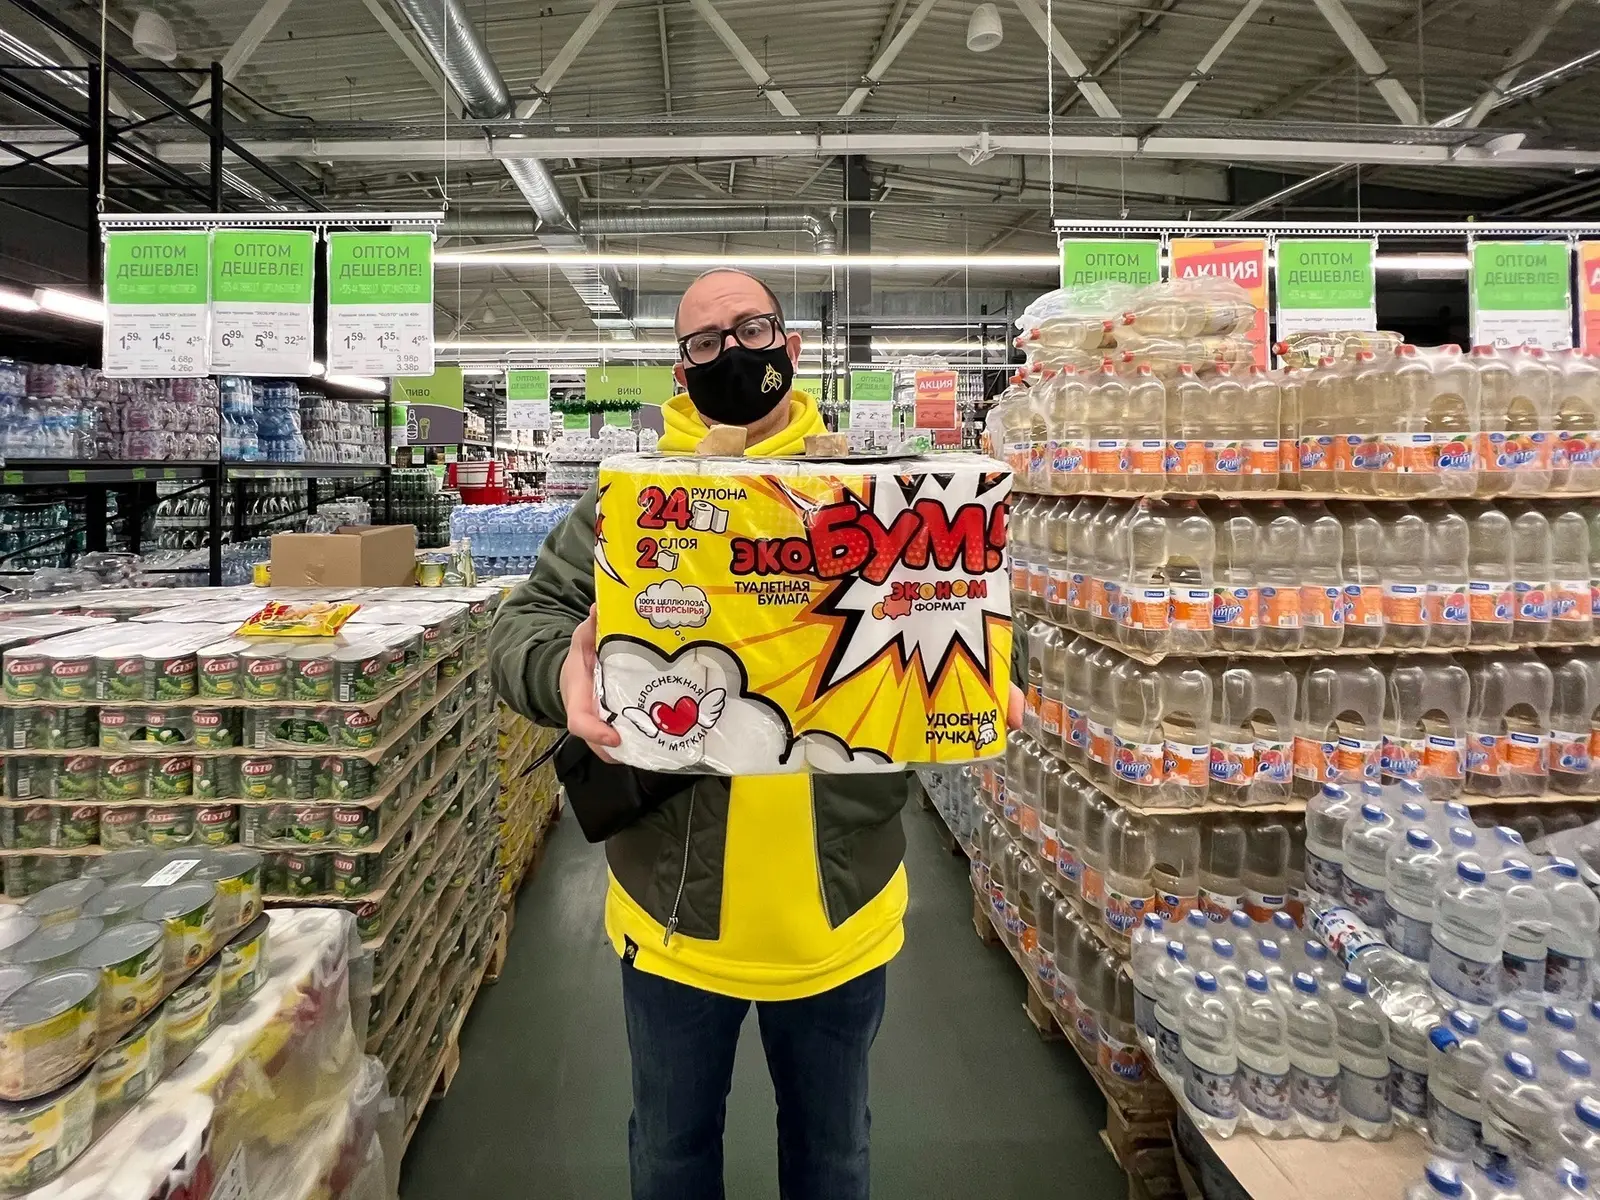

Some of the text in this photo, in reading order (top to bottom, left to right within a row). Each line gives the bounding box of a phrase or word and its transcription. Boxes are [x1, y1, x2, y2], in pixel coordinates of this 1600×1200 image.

[131, 245, 186, 259] ОПТОМ
[234, 243, 291, 258] ОПТОМ
[352, 245, 409, 259] ОПТОМ
[1085, 253, 1140, 266] ОПТОМ
[1299, 252, 1353, 265] ОПТОМ
[1495, 254, 1548, 267] ОПТОМ
[116, 262, 199, 279] ДЕШЕВЛЕ!
[220, 261, 303, 277] ДЕШЕВЛЕ!
[339, 262, 422, 280] ДЕШЕВЛЕ!
[1182, 260, 1259, 281] АКЦИЯ
[1288, 270, 1365, 286] ДЕШЕВЛЕ!
[1484, 271, 1560, 286] ДЕШЕВЛЕ!
[396, 354, 420, 364] 3.98р
[396, 363, 420, 373] 3.38р
[617, 387, 642, 396] ВИНО
[919, 379, 953, 390] АКЦИЯ
[405, 388, 430, 397] ПИВО
[636, 485, 748, 532] 24 РУЛОНА
[635, 536, 698, 570] 2 СЛОЯ
[735, 580, 811, 593] ТУАЛЕТНАЯ
[890, 579, 988, 601] ЭКОНОМ
[657, 599, 704, 607] ЦЕЛЛЮЛОЗА
[757, 592, 811, 606] БУМАГА
[639, 605, 705, 615] БЕЗ ВТОРСЫРЬЯ
[914, 601, 967, 613] ФОРМАТ
[57, 664, 89, 674] GUSTO
[637, 674, 704, 710] БЕЛОСНЕЖНАЯ
[925, 708, 998, 727] УДОБНАЯ
[658, 728, 708, 751] И МЯГКАЯ
[925, 730, 977, 745] РУЧКА
[245, 764, 274, 774] GUSTO
[200, 811, 232, 822] GUSTO
